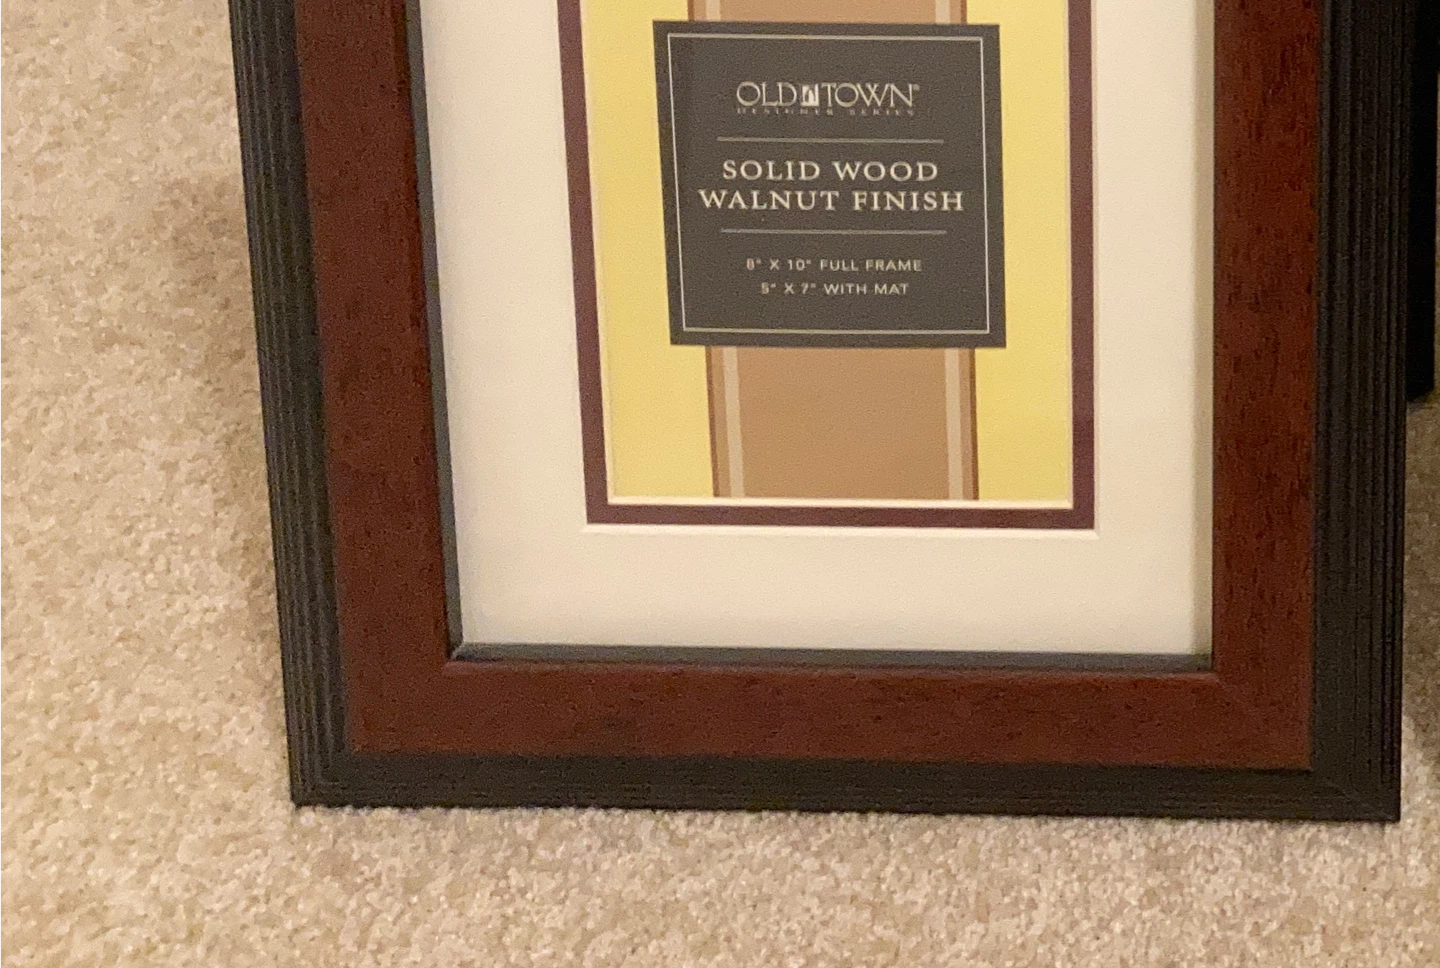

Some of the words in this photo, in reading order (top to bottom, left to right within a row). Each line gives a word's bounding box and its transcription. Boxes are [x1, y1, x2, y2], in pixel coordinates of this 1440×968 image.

[736, 81, 797, 107] OLD
[722, 159, 821, 181] SOLID
[831, 160, 938, 182] WOOD
[697, 188, 840, 211] WALNUT
[851, 190, 964, 212] FINISH
[746, 258, 762, 271] 8"
[769, 258, 780, 271] X
[787, 258, 812, 272] 10"
[819, 258, 859, 272] FULL
[865, 259, 922, 272] FRAME
[761, 281, 777, 295] 5"
[784, 282, 795, 295] X
[800, 282, 817, 295] 7"
[823, 282, 868, 295] WITH
[874, 282, 910, 295] MAT
